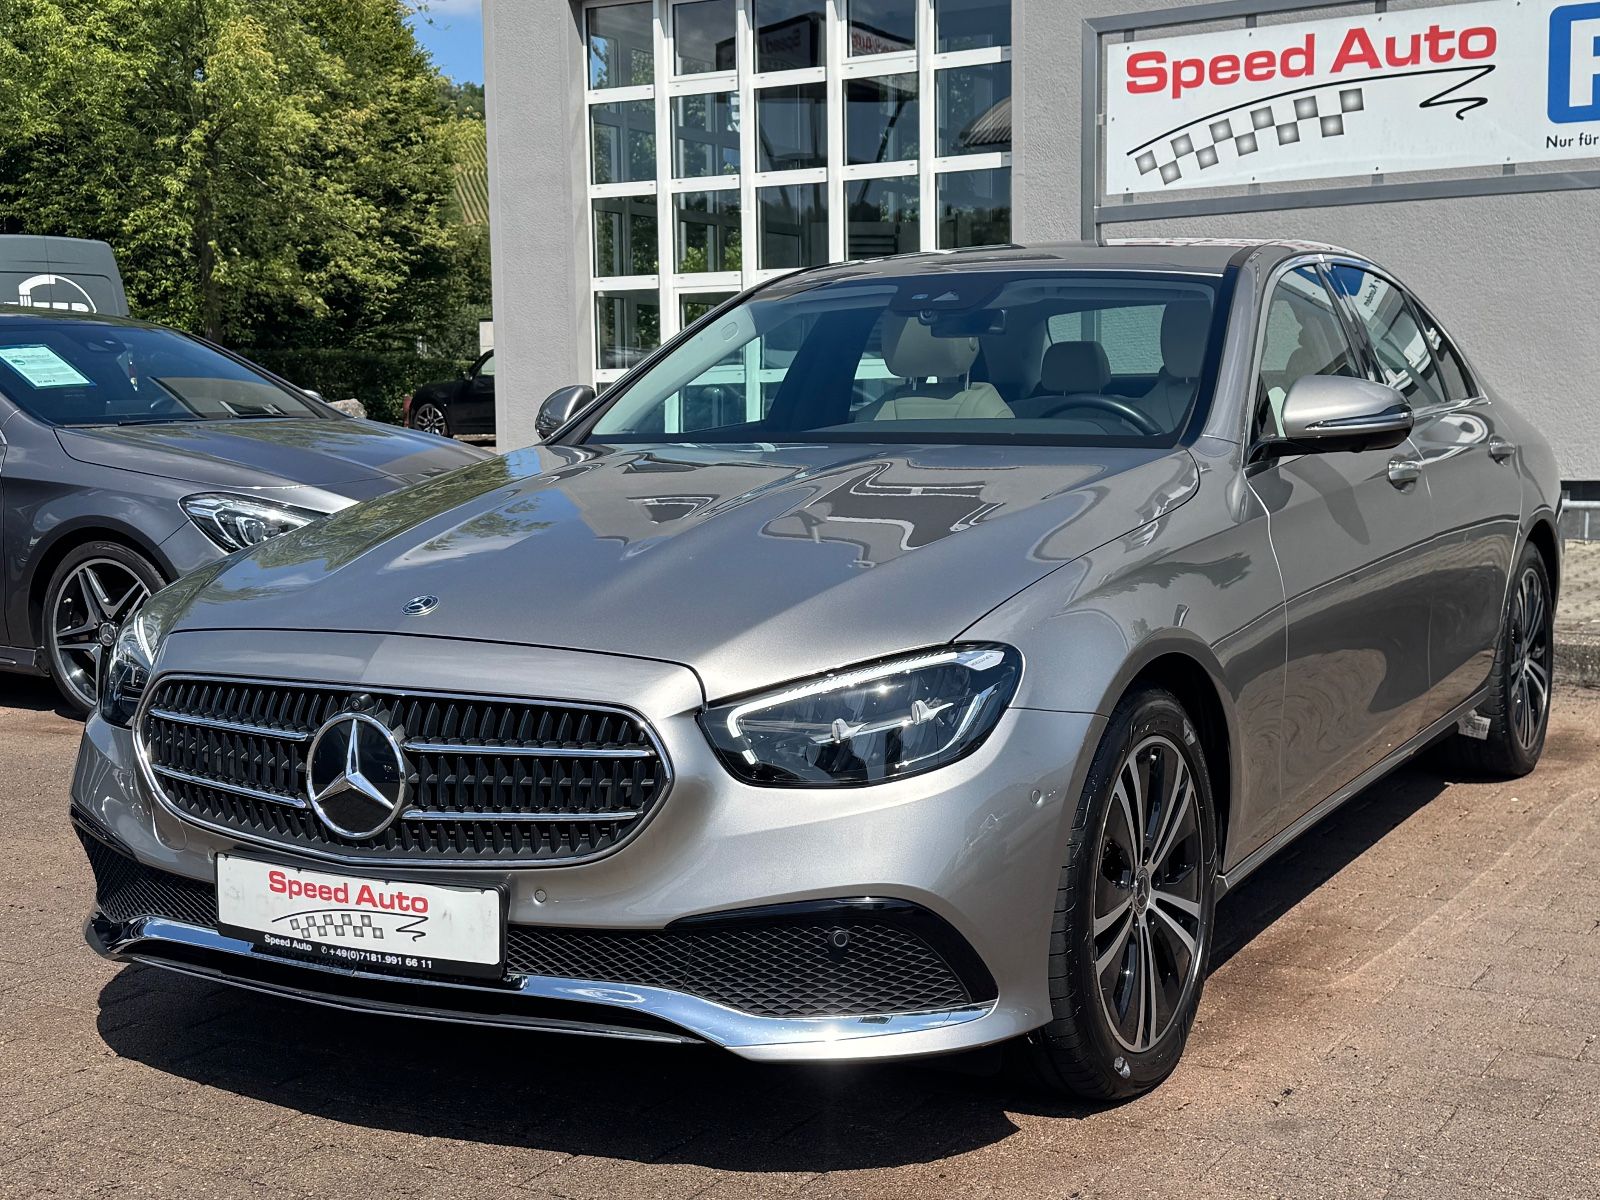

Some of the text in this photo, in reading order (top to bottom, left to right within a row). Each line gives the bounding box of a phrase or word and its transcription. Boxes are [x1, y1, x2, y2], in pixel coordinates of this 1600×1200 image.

[1126, 24, 1498, 99] Speed Auto
[1546, 131, 1600, 149] Nur für
[268, 870, 429, 914] Speed Auto
[264, 934, 313, 952] Speed Auto
[405, 958, 419, 967] 66
[421, 960, 433, 969] 11
